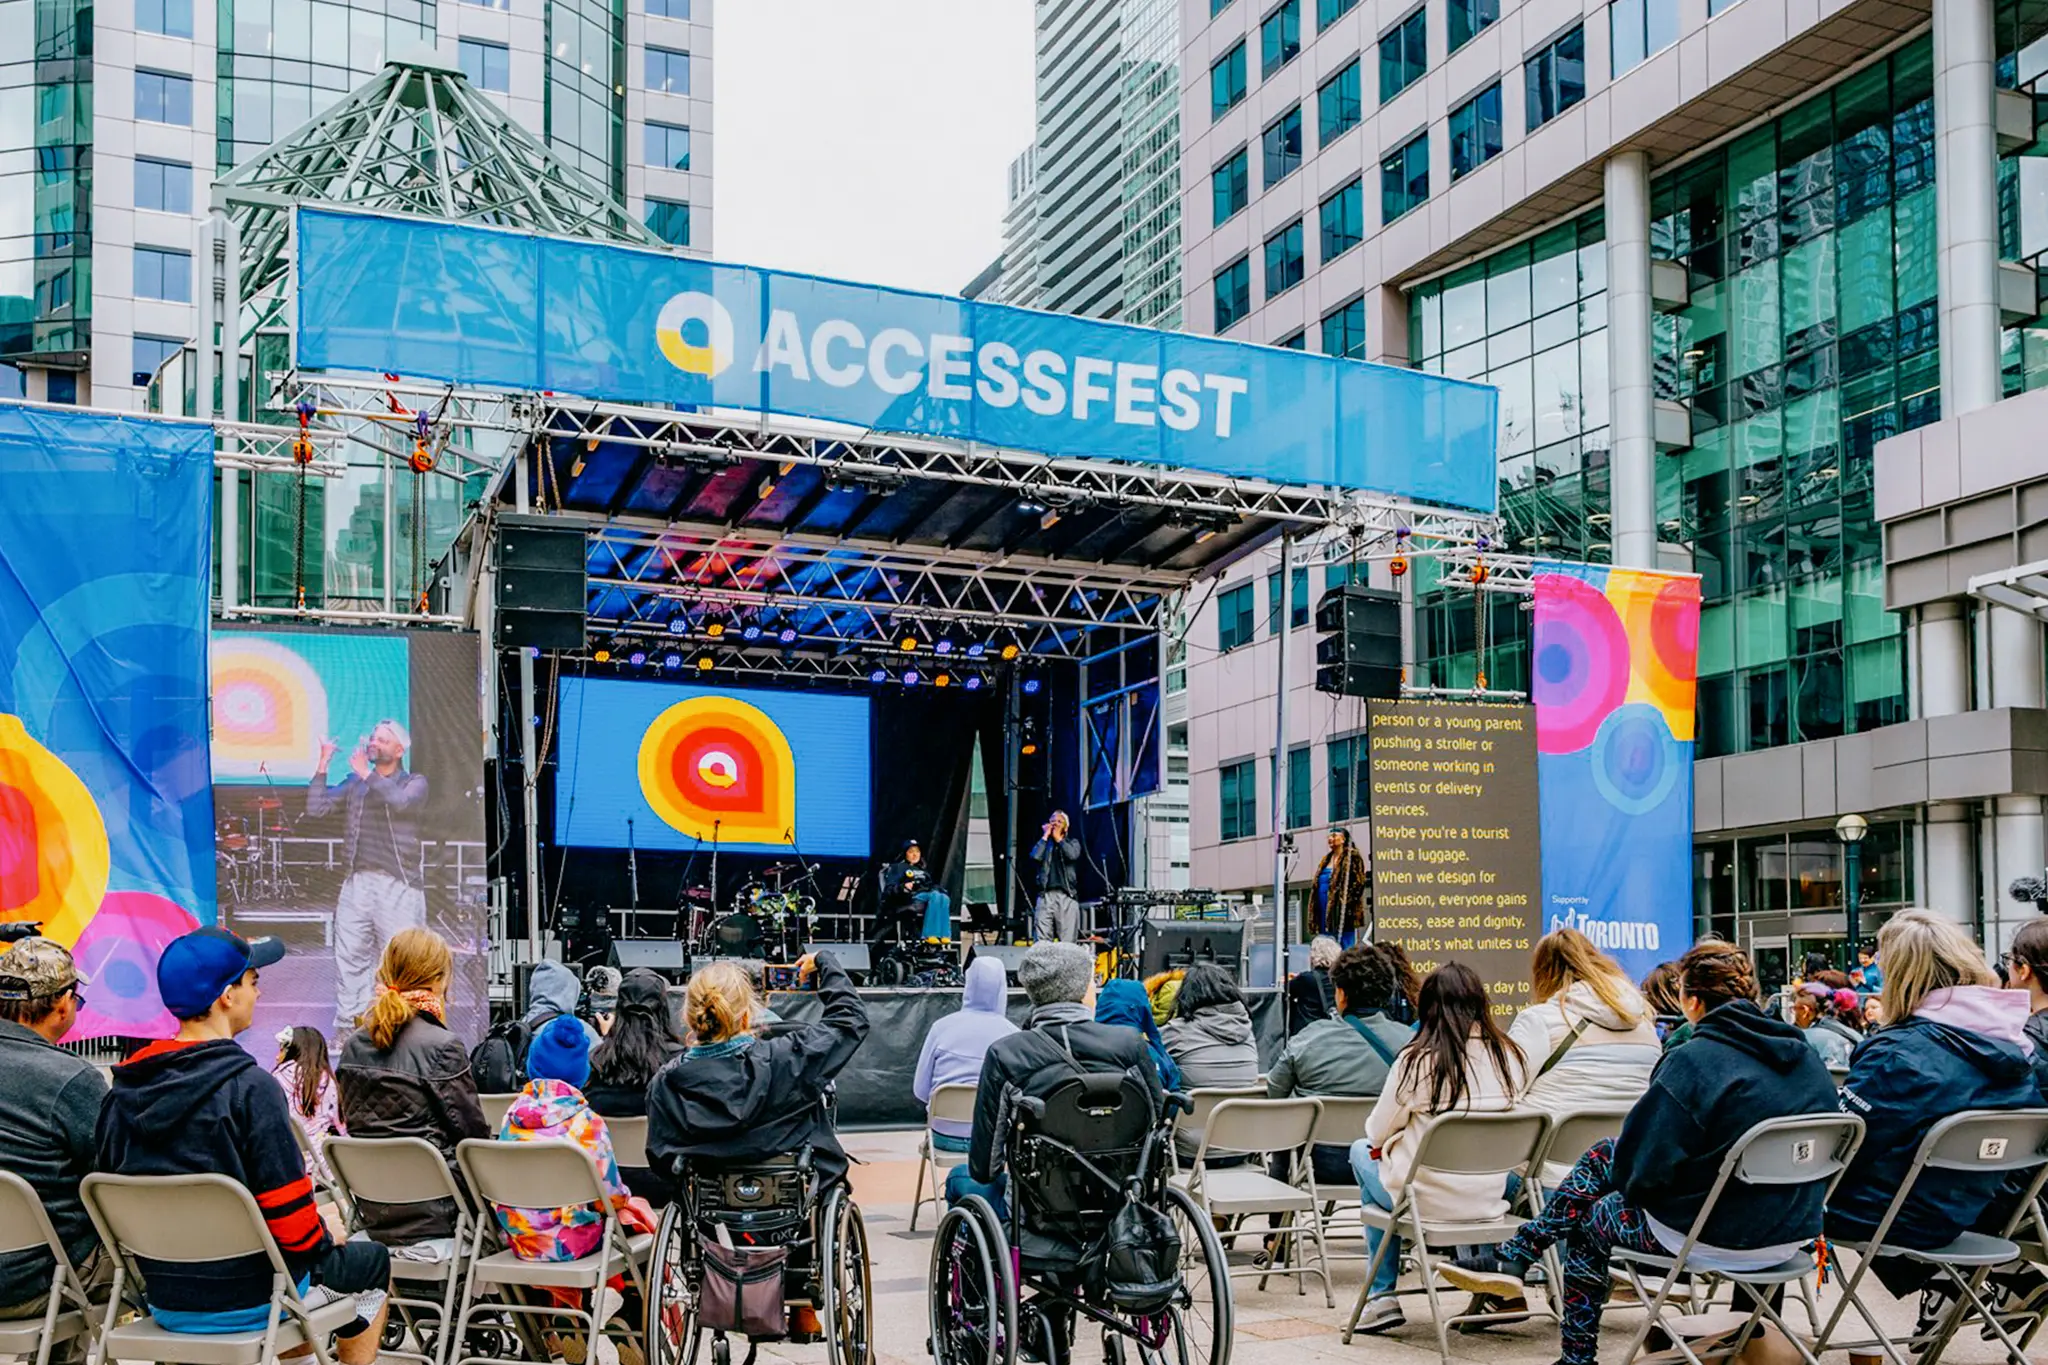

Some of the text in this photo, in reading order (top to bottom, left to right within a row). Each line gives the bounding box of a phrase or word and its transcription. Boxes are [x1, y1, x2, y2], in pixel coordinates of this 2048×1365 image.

[752, 309, 1248, 438] ACCESSFEST
[1373, 715, 1523, 731] person or a young parent
[1373, 735, 1493, 751] pushing a stroller or
[1374, 760, 1494, 775] someone working in
[1375, 782, 1482, 797] events or delivery
[1375, 805, 1428, 816] services.
[1376, 826, 1509, 840] Maybe you're a tourist
[1377, 848, 1469, 863] with a luggage.
[1378, 870, 1495, 885] When we design for
[1378, 893, 1527, 908] inclusion, everyone gains
[1379, 915, 1525, 930] access, ease and dignity.
[1577, 914, 1660, 950] TORONTO
[1407, 938, 1441, 951] that's
[1445, 938, 1474, 950] what
[1477, 938, 1512, 949] unites
[1516, 939, 1529, 949] us
[1411, 960, 1441, 973] toda
[1493, 981, 1515, 995] day
[1518, 981, 1530, 993] to
